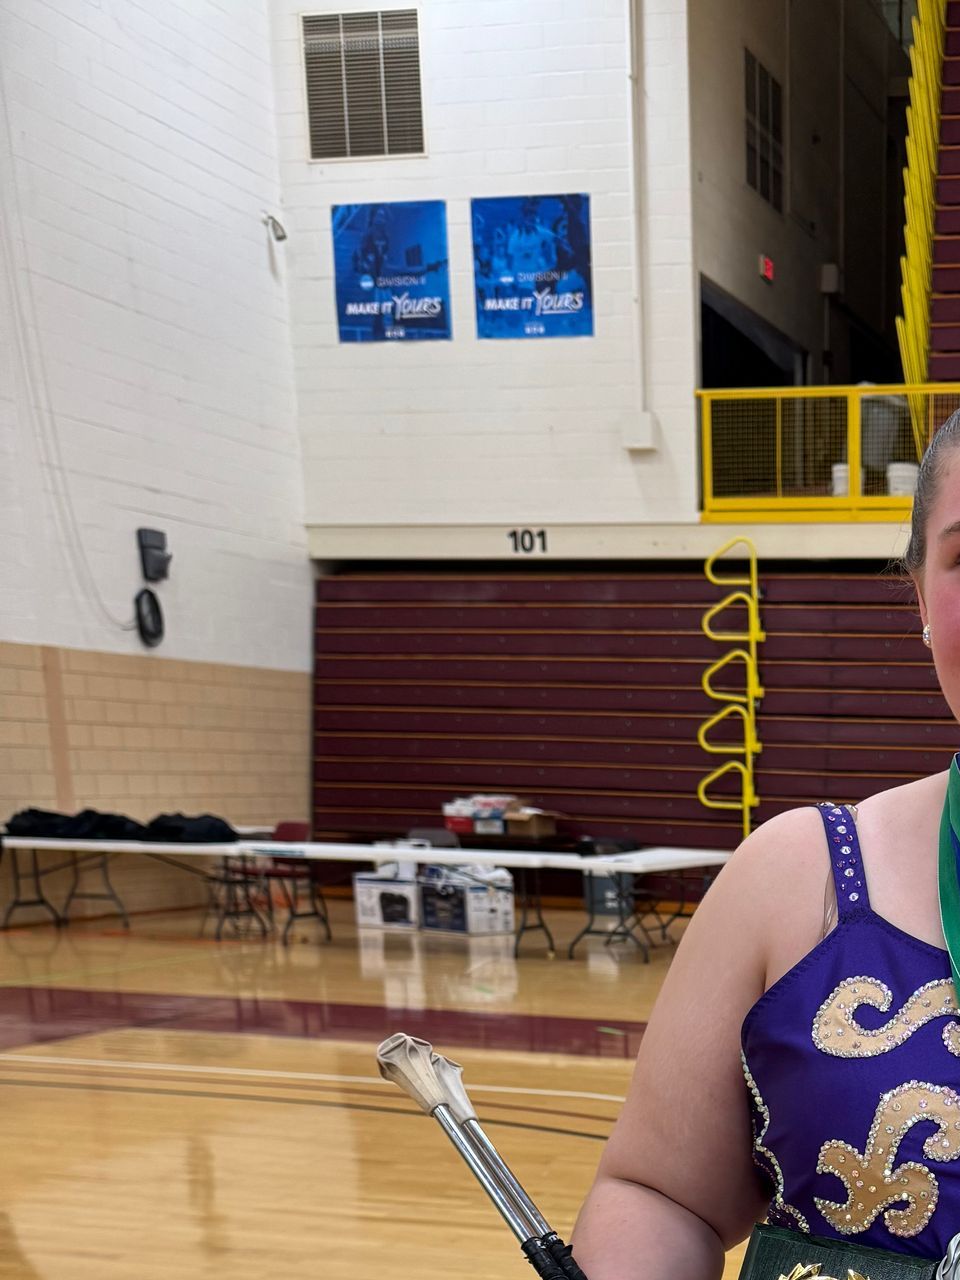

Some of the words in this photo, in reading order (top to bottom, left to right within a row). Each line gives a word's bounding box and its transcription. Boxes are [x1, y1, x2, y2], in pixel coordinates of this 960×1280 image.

[346, 301, 380, 315] MAKE
[382, 300, 394, 314] IT
[484, 298, 520, 310] MAKE
[521, 297, 534, 310] IT
[507, 530, 548, 553] 101
